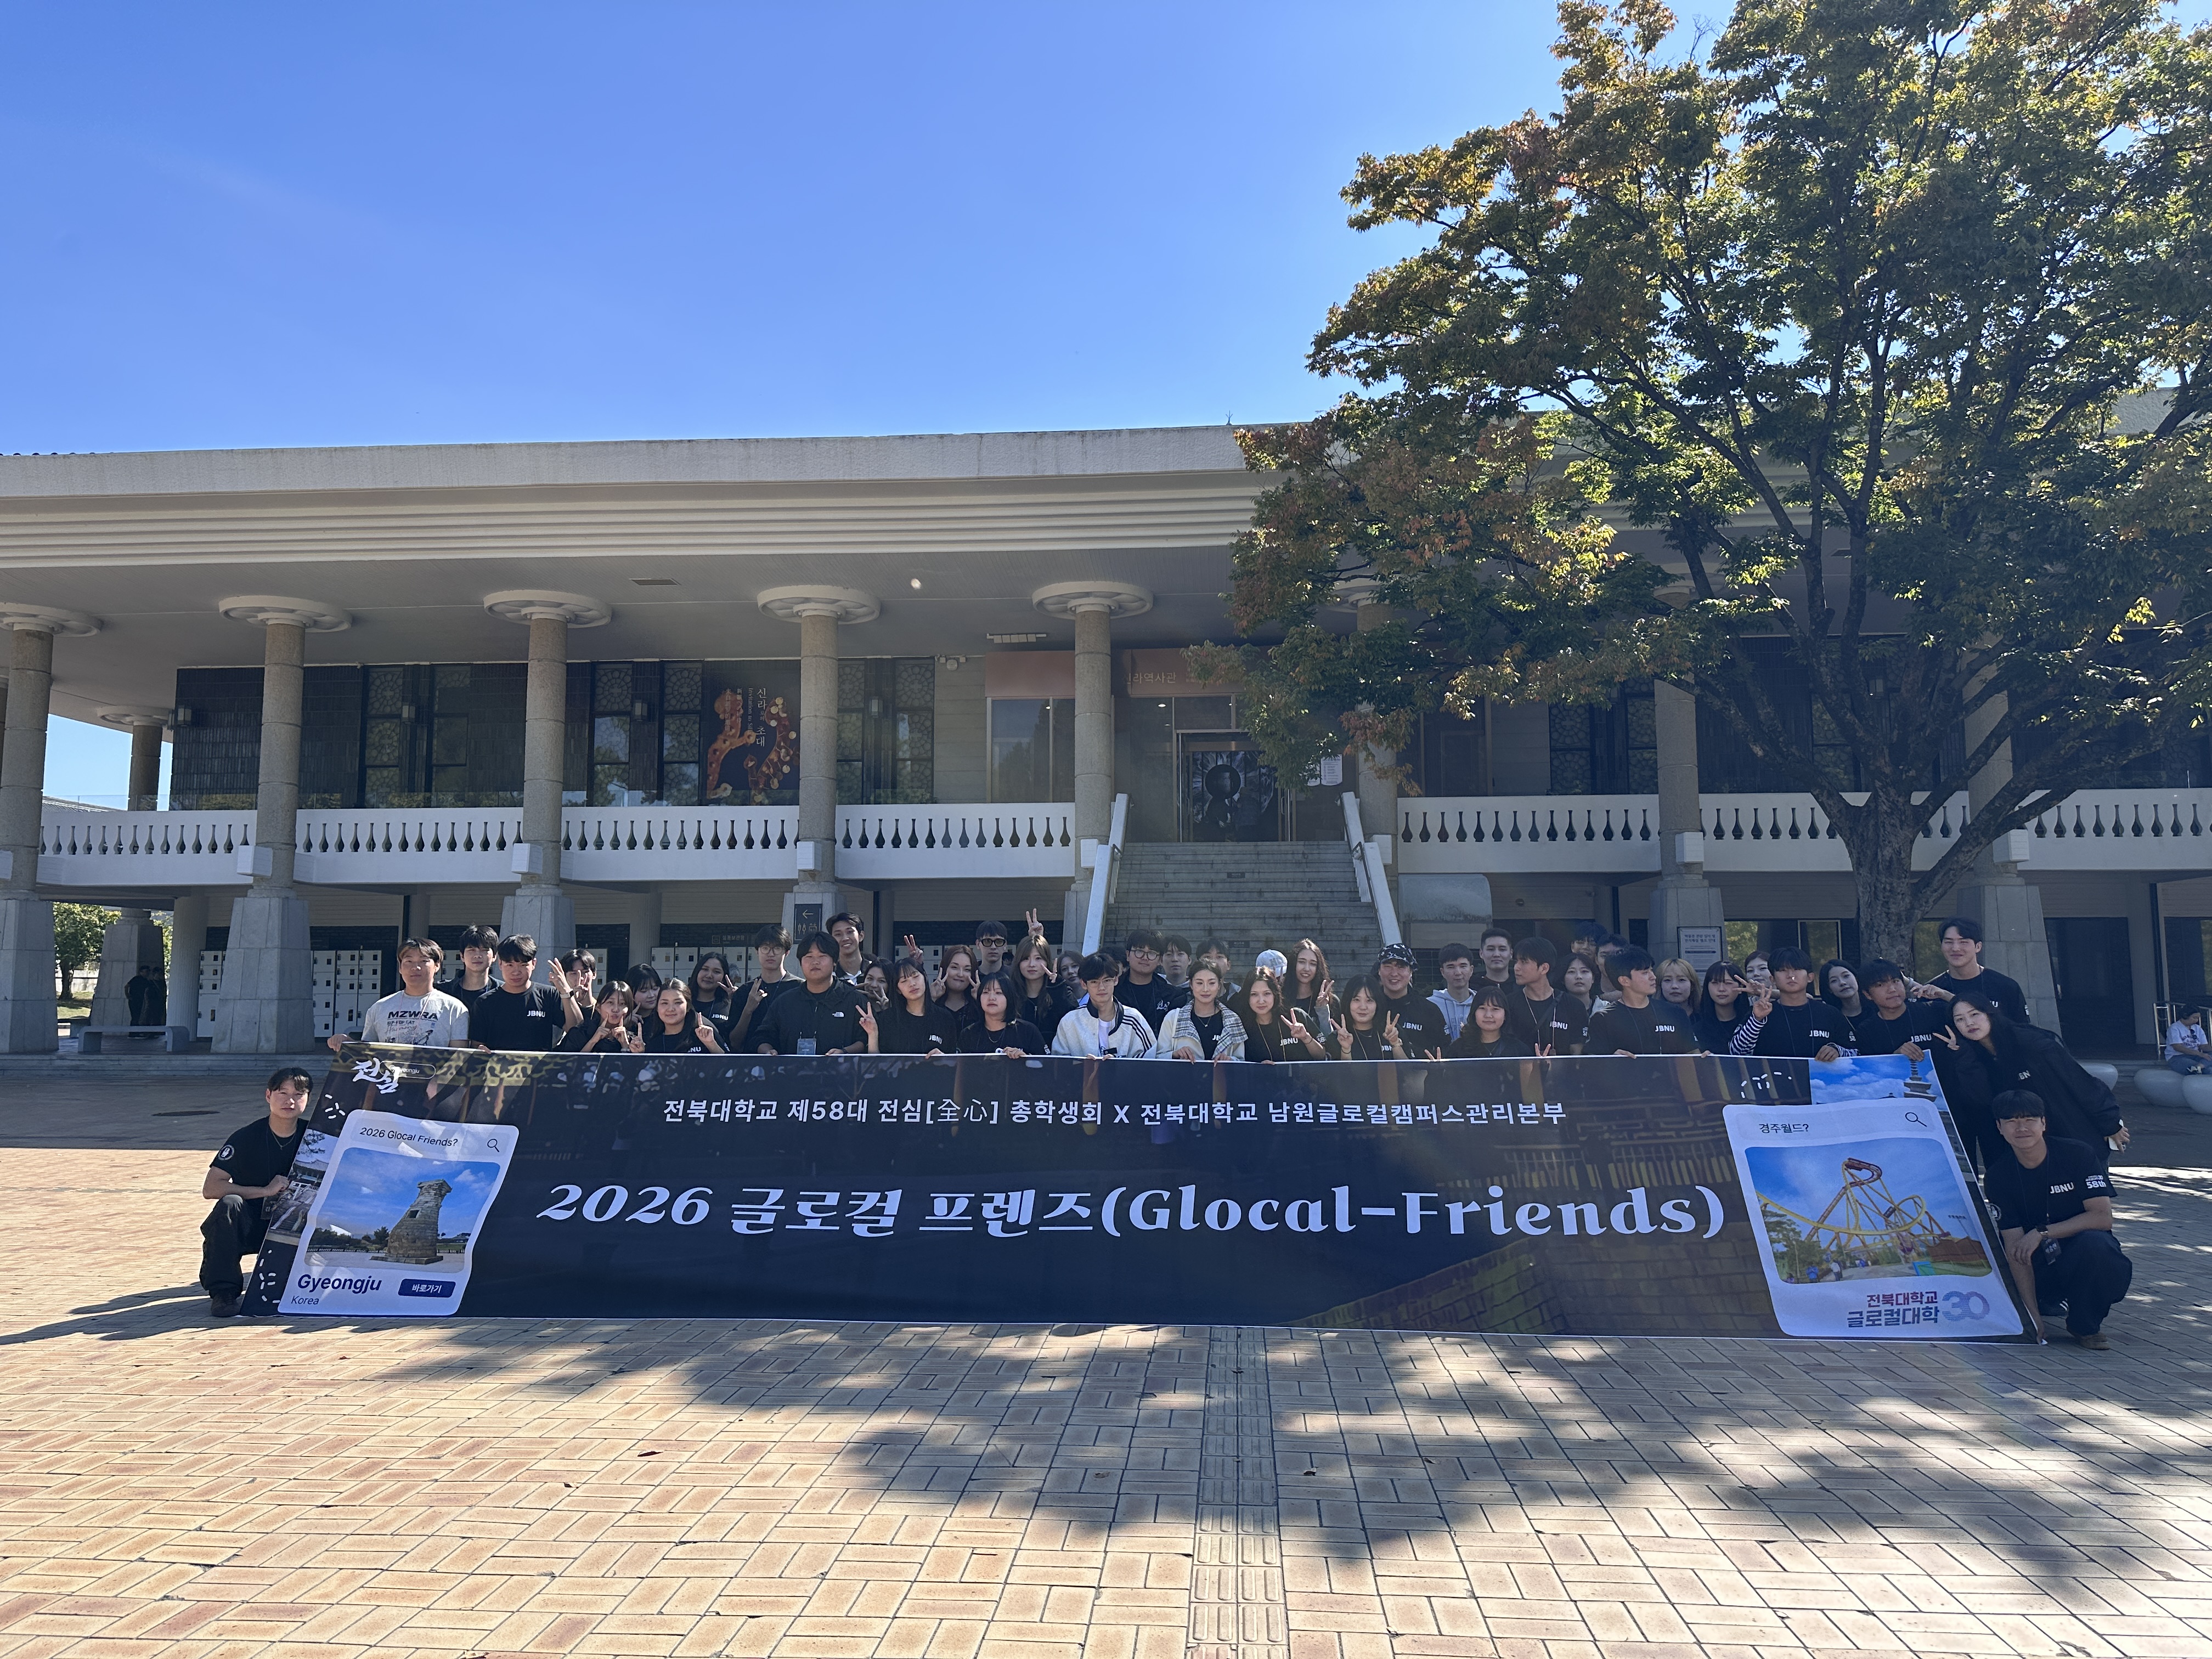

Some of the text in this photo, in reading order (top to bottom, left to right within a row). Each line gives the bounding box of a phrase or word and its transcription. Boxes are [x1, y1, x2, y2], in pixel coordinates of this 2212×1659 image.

[756, 725, 766, 747] 초대
[388, 1011, 438, 1021] MZWRA
[1402, 1022, 1423, 1031] JBNU
[1549, 1021, 1568, 1030] JBNU
[1809, 1030, 1830, 1038] JBNU
[1910, 1034, 1932, 1042] JBNU
[929, 1035, 943, 1045] JBNU
[1280, 1037, 1299, 1046] JBNU
[351, 1057, 399, 1094] 전심
[663, 1099, 777, 1122] 전북대학교
[787, 1099, 868, 1122] 제58대
[878, 1099, 998, 1124] 전심[全心]
[1010, 1099, 1102, 1125] 총학생회
[1141, 1102, 1258, 1125] 전북대학교
[1268, 1102, 1566, 1125] 남원글로컬캠퍼스관리본부
[1759, 1123, 1809, 1133] 경주월드?
[359, 1127, 458, 1147] 2026 Glocal Friends?
[2050, 1182, 2074, 1194] JBNU
[2086, 1180, 2107, 1189] 58th
[536, 1184, 1724, 1239] 2026 글로컬 프렌즈(Glocal-Friends)
[297, 1274, 382, 1294] Gyeongju
[411, 1284, 442, 1294] 바로가기
[291, 1295, 319, 1305] Korea
[1866, 1291, 1938, 1308] 전북대학교
[1942, 1291, 1990, 1322] 30
[1847, 1306, 1940, 1328] 글로컬대학
